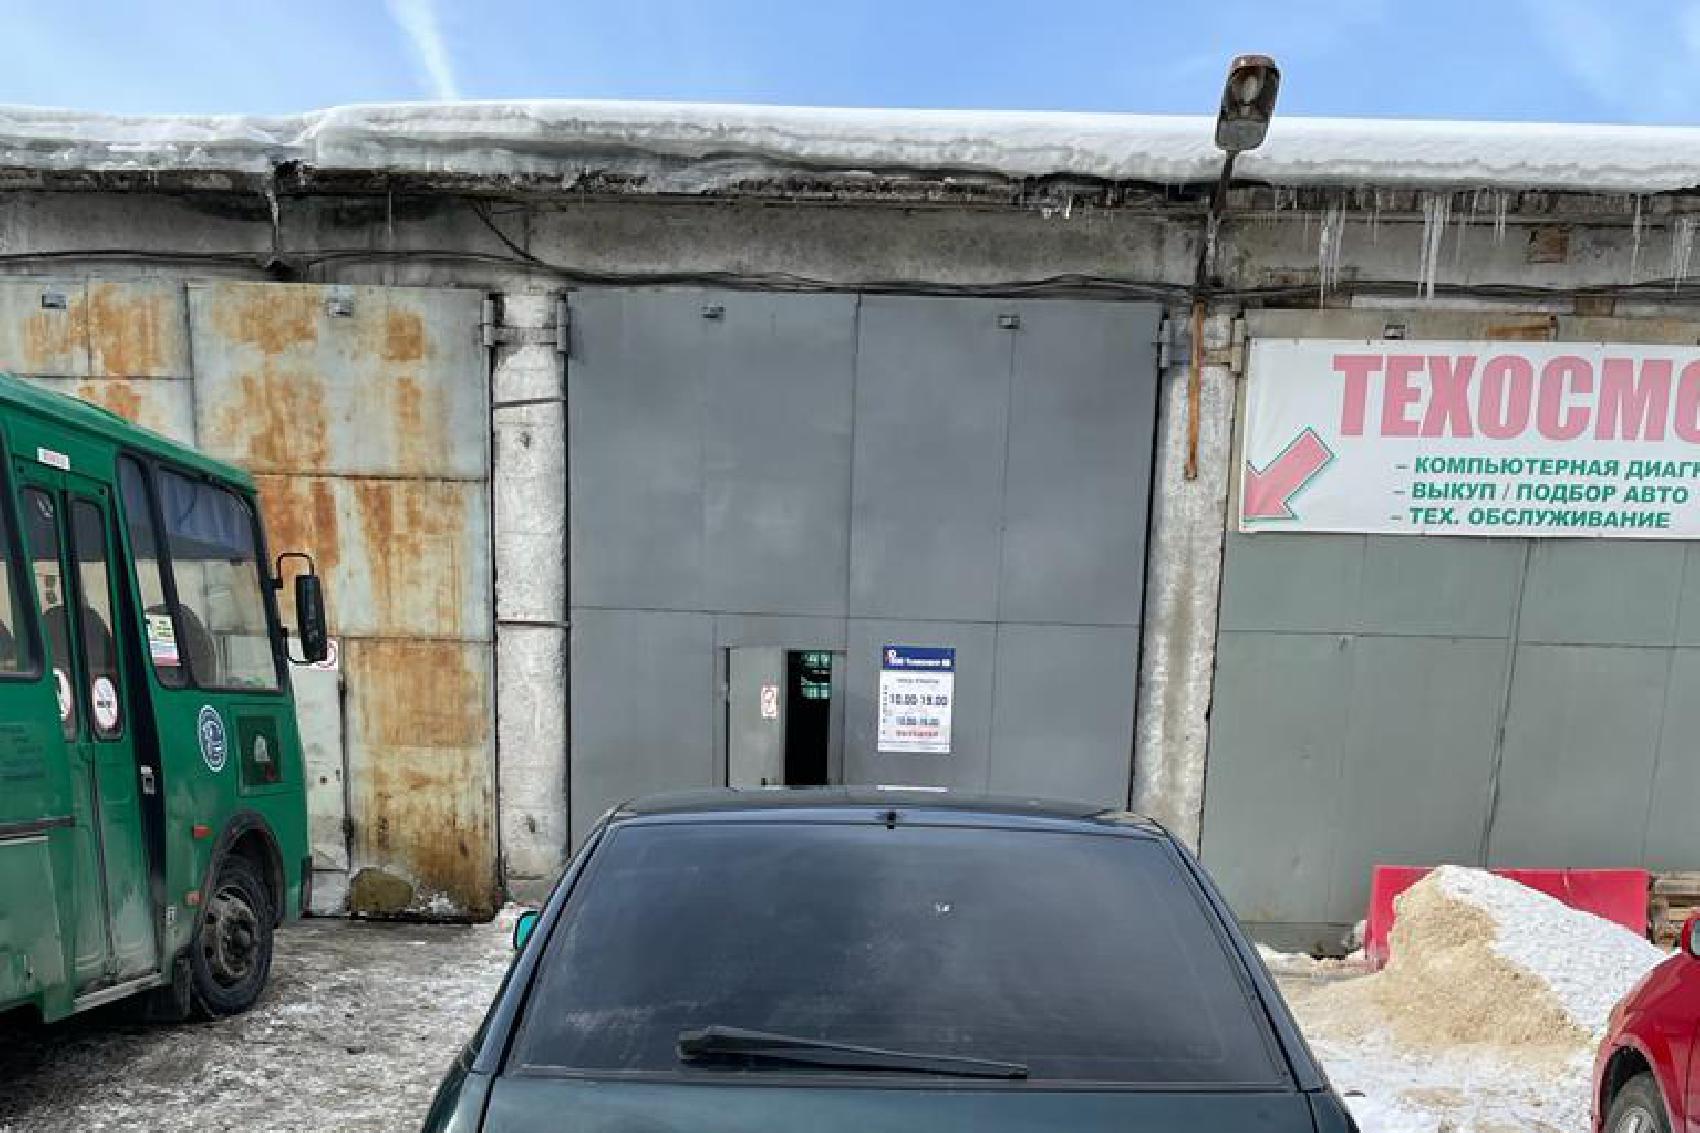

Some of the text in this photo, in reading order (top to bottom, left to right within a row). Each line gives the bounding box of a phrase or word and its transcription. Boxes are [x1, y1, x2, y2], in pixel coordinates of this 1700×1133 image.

[1415, 457, 1619, 476] КОМПЬЮТЕРНАЯ
[1412, 482, 1496, 501] ВЫКУП
[1517, 484, 1616, 504] ПОДБОР
[1624, 485, 1689, 504] АВТО
[1410, 507, 1459, 525] ТЕХ.
[1468, 508, 1671, 528] ОБСЛУЖИВАНИЕ
